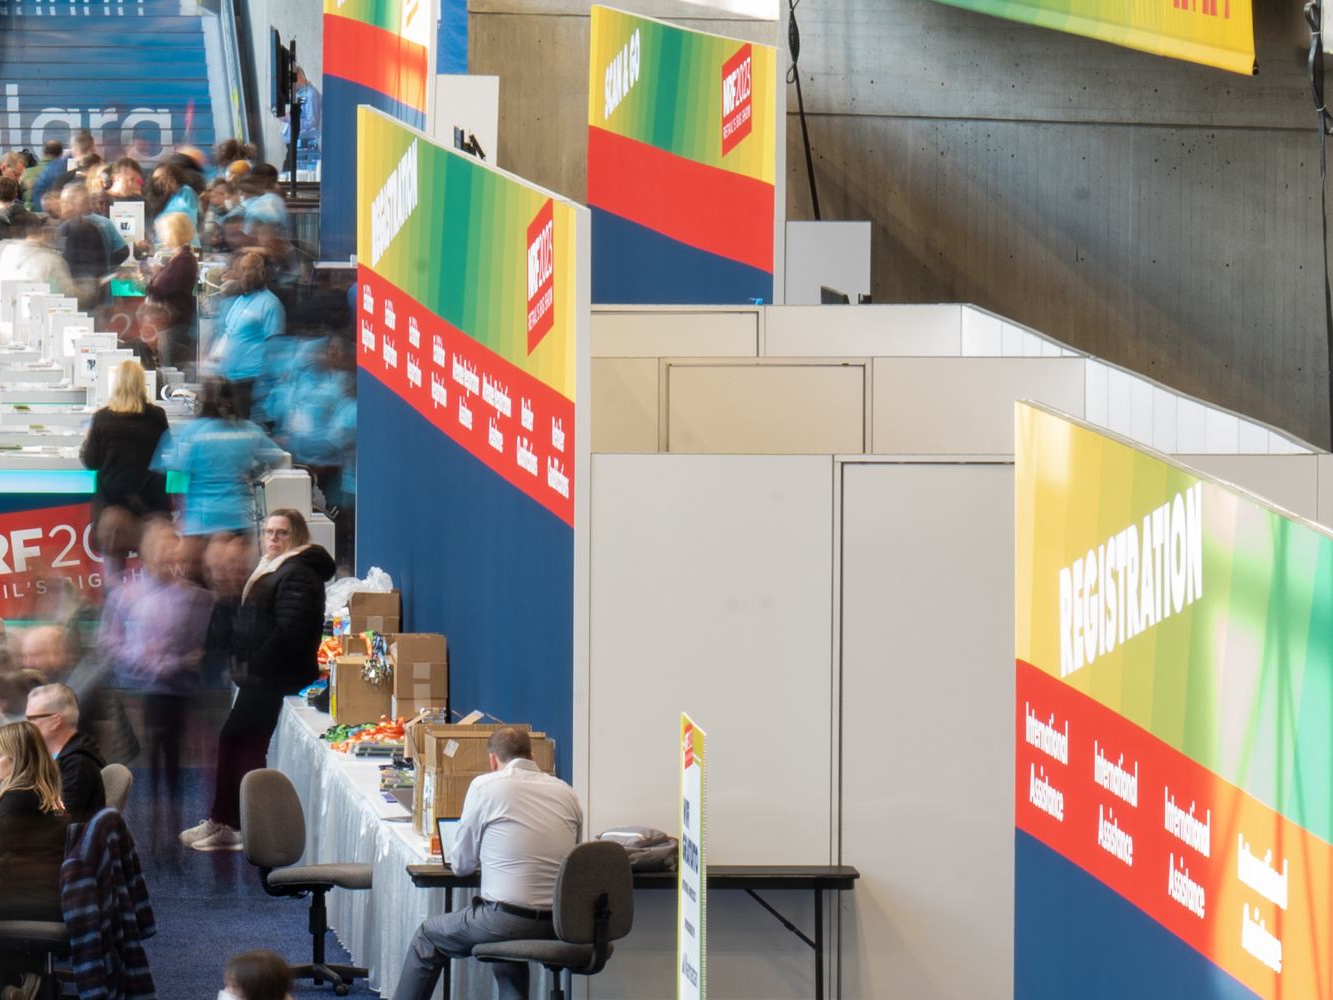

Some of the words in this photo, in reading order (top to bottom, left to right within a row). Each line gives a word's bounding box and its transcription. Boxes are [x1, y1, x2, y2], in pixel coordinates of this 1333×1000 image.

[604, 51, 622, 120] SCAN
[629, 28, 640, 88] GO
[1059, 480, 1202, 678] REGISTRATION
[1025, 701, 1068, 765] International
[1029, 763, 1064, 822] Assistance
[1094, 740, 1138, 807] International
[1098, 804, 1133, 867] Assistance
[1165, 786, 1210, 858] International
[1168, 853, 1205, 919] Assistance
